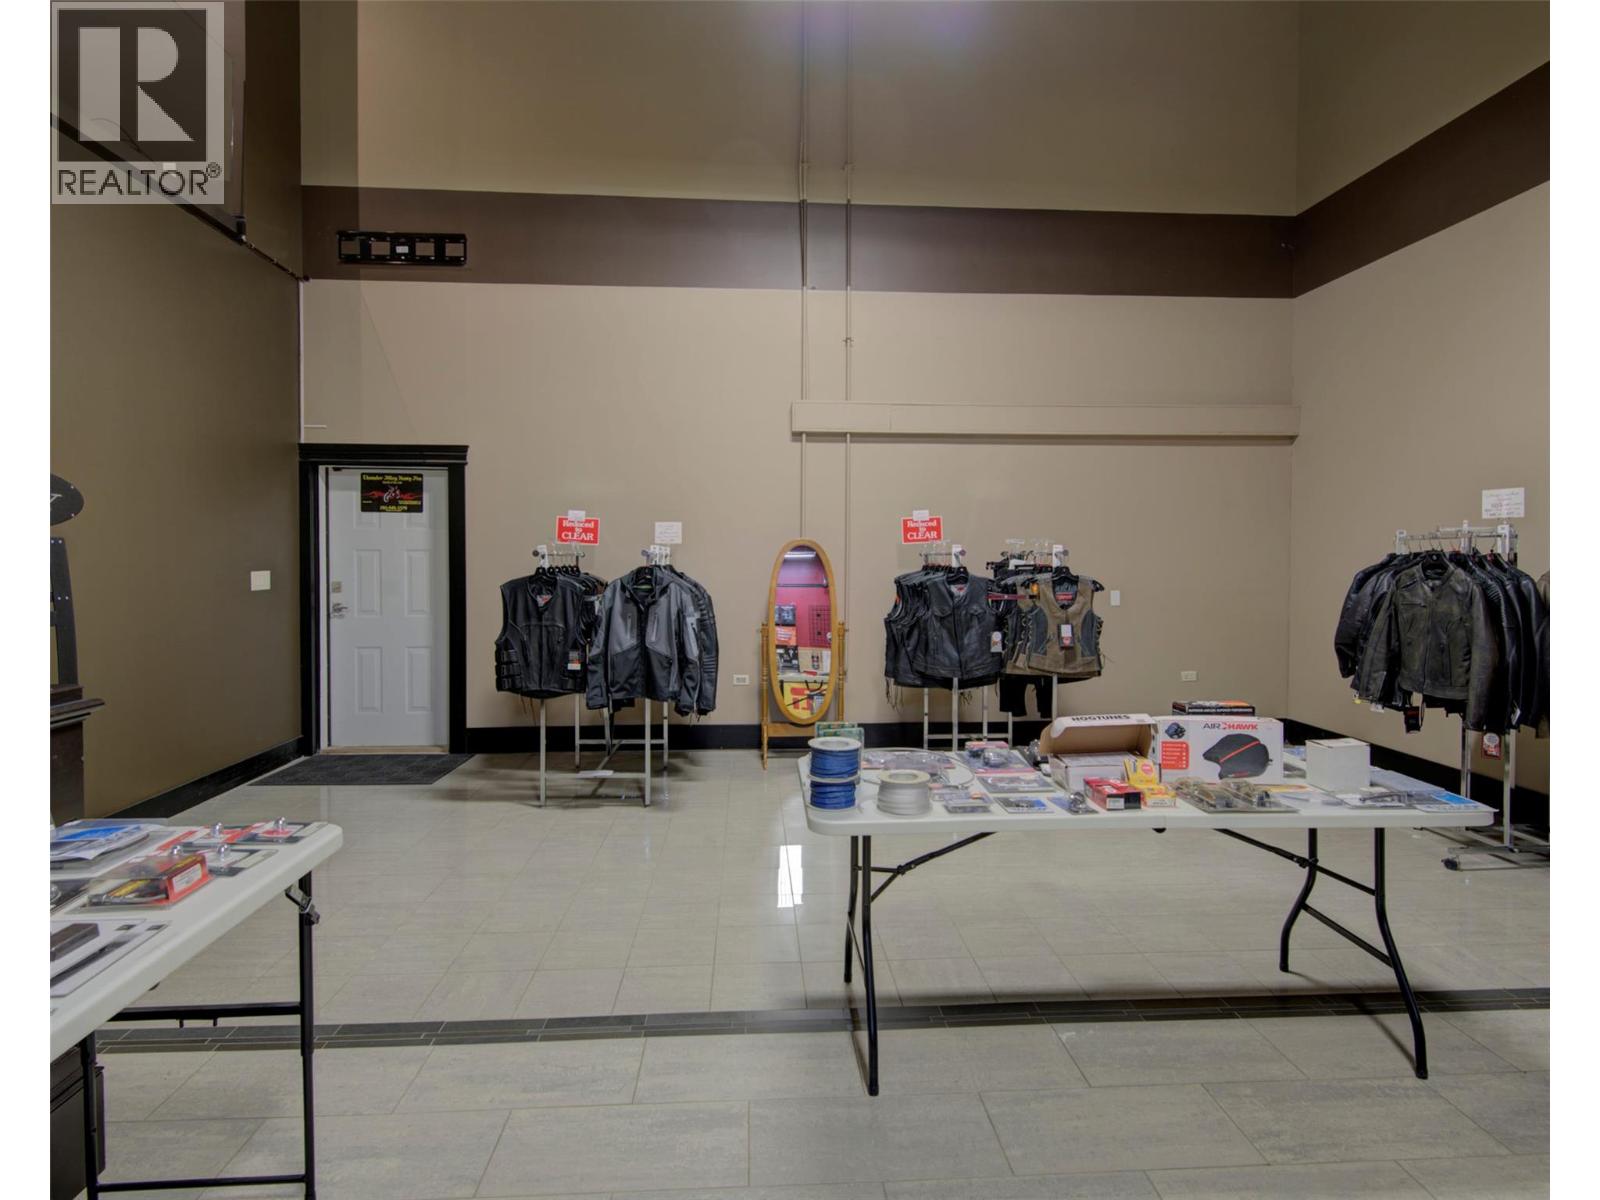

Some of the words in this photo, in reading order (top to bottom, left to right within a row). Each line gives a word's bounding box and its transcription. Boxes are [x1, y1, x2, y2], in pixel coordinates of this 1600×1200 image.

[561, 531, 594, 541] CLEAR
[907, 530, 937, 540] CLEAR
[1071, 713, 1130, 722] HOGTUNES
